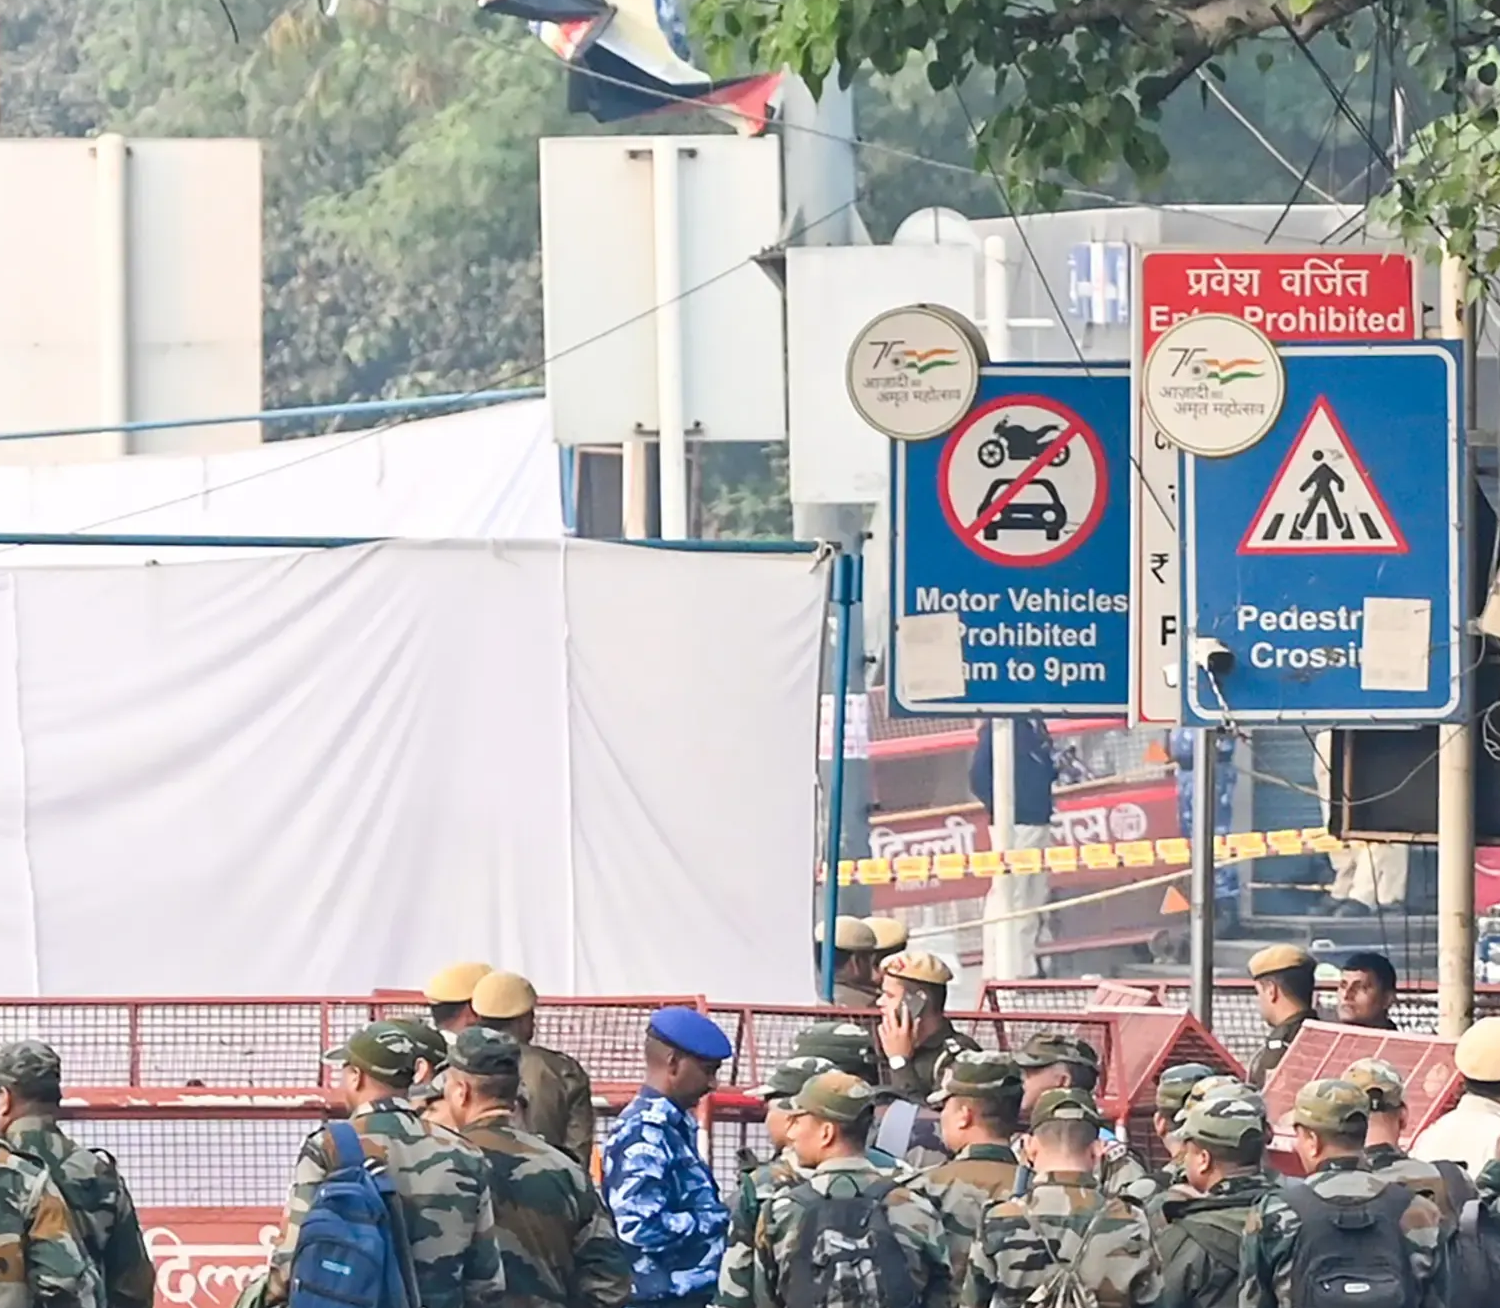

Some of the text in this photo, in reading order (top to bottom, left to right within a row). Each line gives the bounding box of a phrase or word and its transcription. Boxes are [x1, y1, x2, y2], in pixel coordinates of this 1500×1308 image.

[1186, 257, 1370, 297] प्रवेश वर्जित
[1243, 305, 1406, 333] Prohibited
[915, 587, 1129, 613] Motor Vehicles
[1237, 604, 1362, 631] Pedestr
[959, 622, 1097, 647] rohibited
[1250, 641, 1363, 669] Crossi
[1006, 660, 1036, 681] to
[1044, 657, 1106, 687] 9pm
